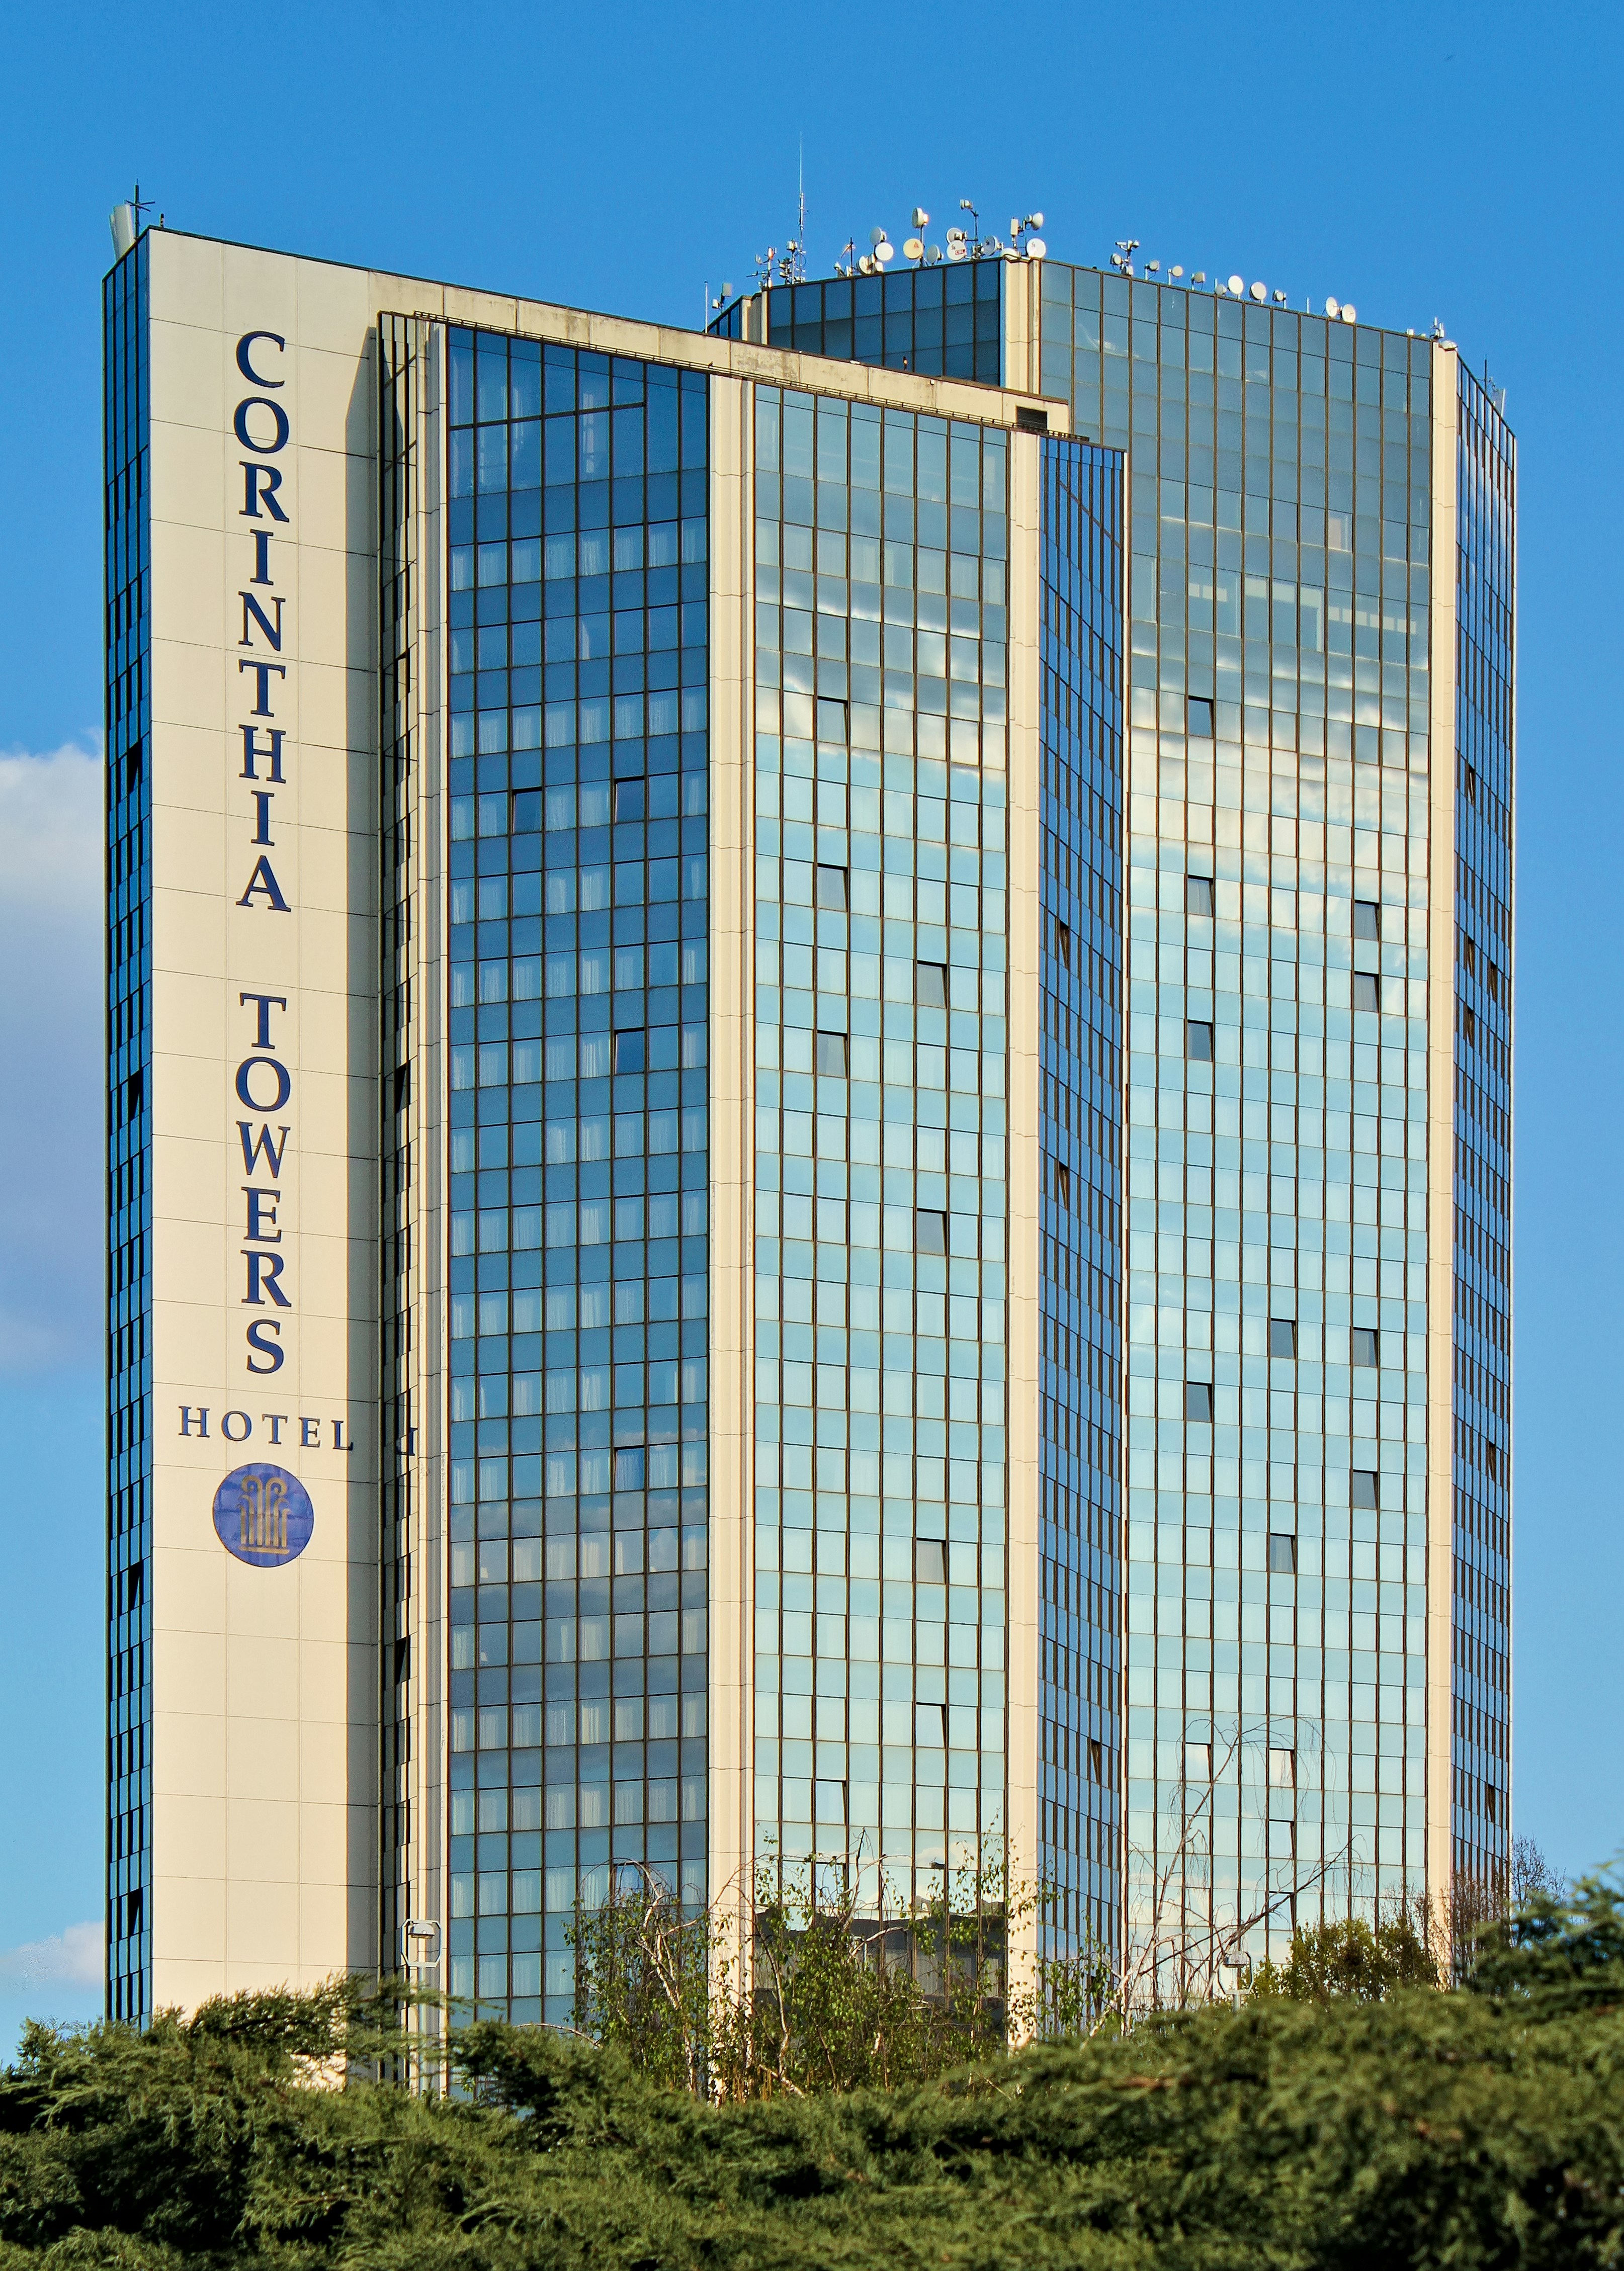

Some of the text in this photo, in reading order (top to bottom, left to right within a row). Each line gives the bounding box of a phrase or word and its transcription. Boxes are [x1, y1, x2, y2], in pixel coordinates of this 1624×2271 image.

[233, 330, 292, 1374] CORINTHIA TOWERS
[178, 1405, 354, 1451] HOTEL
